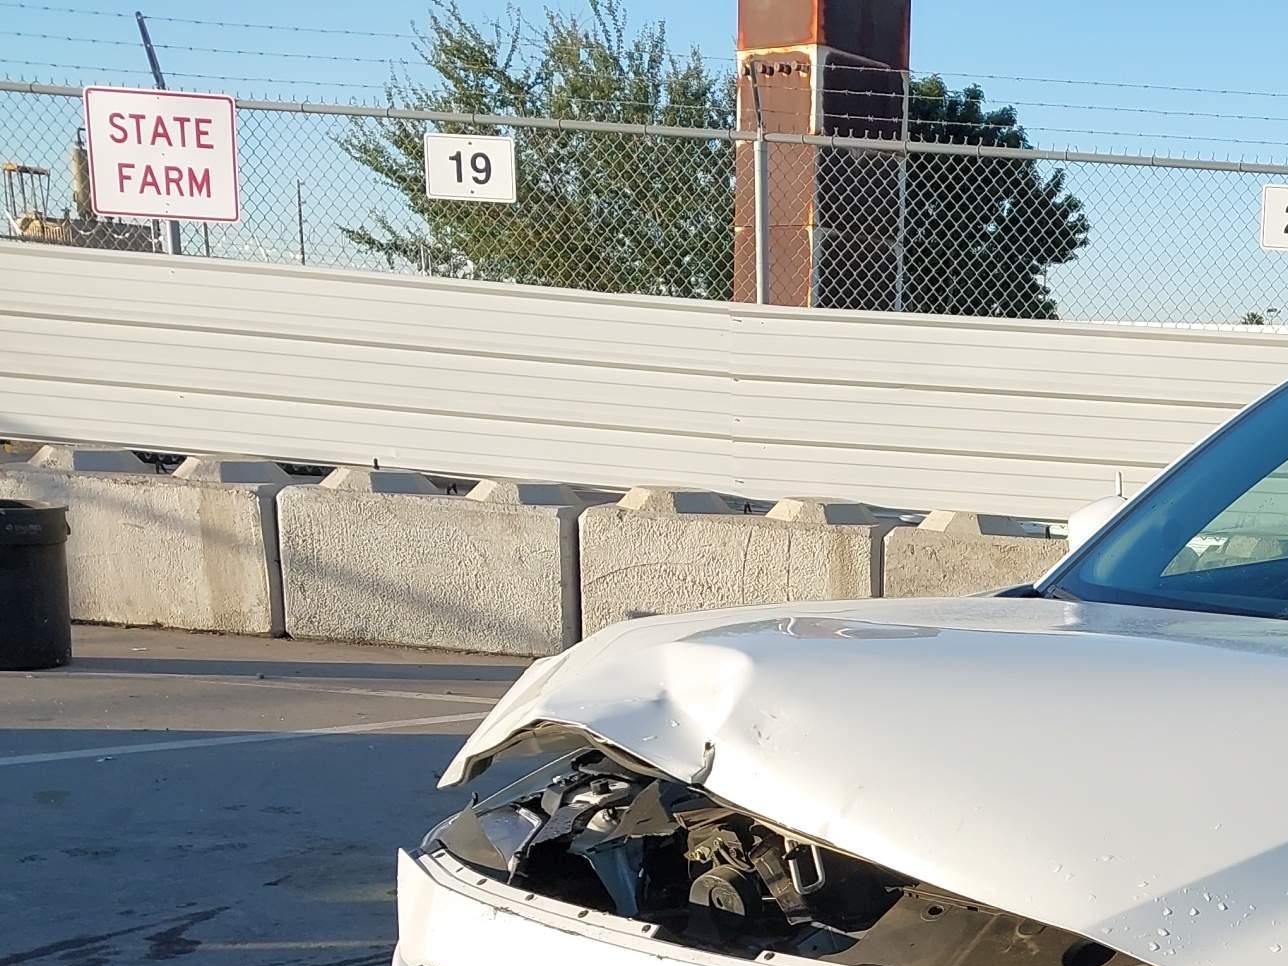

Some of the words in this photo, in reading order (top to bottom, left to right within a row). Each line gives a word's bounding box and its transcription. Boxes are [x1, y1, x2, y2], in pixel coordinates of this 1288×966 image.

[109, 112, 214, 149] STATE
[118, 162, 212, 198] FARM
[449, 151, 492, 185] 19
